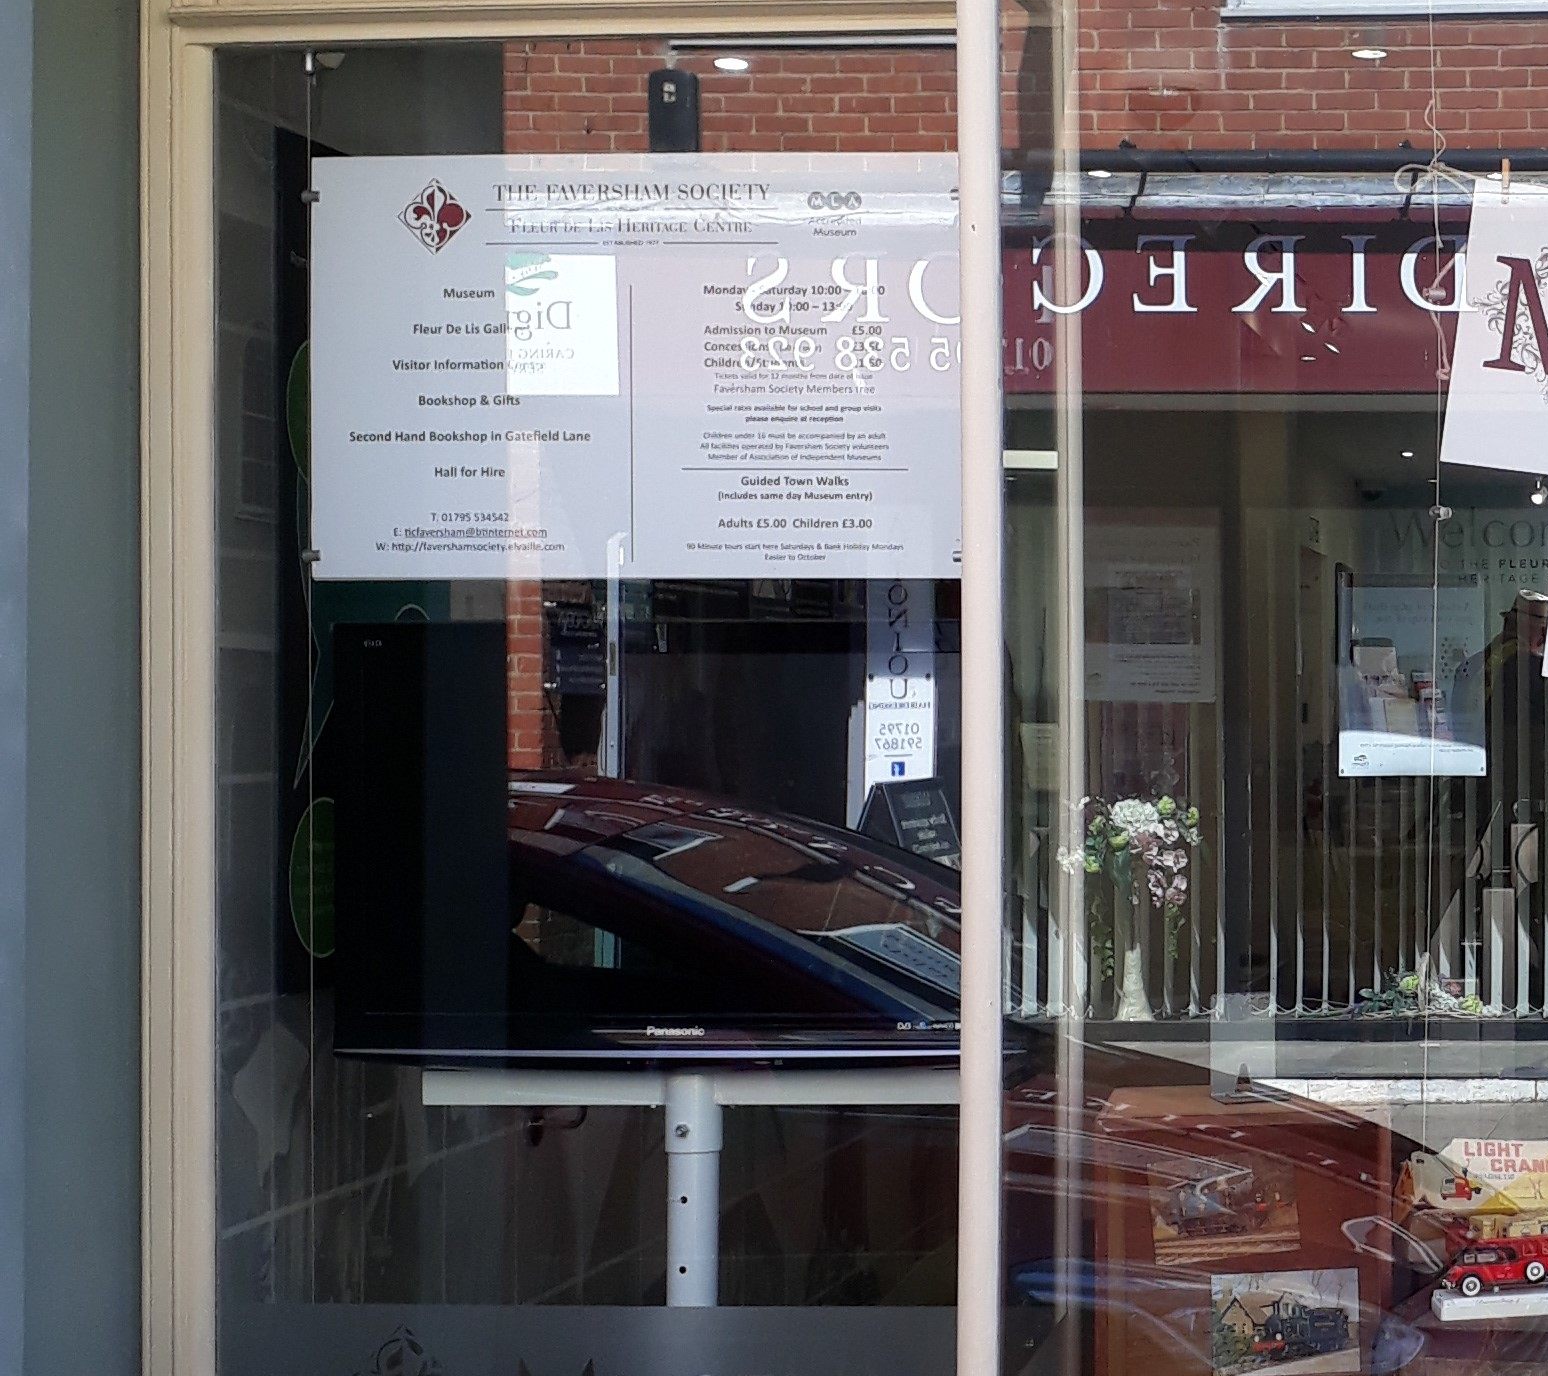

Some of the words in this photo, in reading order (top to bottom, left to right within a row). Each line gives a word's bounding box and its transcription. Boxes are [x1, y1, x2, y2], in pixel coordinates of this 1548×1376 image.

[492, 184, 537, 202] THE
[546, 184, 671, 202] FAVERSHAM
[677, 184, 771, 202] SOCIETY
[813, 226, 858, 238] Museum
[443, 287, 496, 299] Museum
[811, 285, 842, 297] 10:00
[413, 324, 443, 336] Fleur
[446, 324, 463, 336] De
[465, 324, 481, 336] Lis
[703, 326, 762, 336] Admission
[765, 326, 776, 336] to
[779, 326, 828, 336] Museum
[852, 326, 883, 336] £5.00
[392, 359, 432, 371] Visitor
[434, 359, 505, 371] Information
[713, 384, 766, 395] Faversham
[769, 384, 804, 395] Society
[807, 384, 853, 395] Members
[418, 396, 477, 407] Bookshop
[480, 396, 490, 407] &
[493, 396, 521, 407] Gifts
[349, 431, 392, 442] Second
[395, 431, 426, 442] Hand
[430, 431, 488, 442] Bookshop
[490, 431, 502, 442] in
[505, 431, 560, 442] Gatefield
[563, 431, 592, 442] Lane
[434, 467, 457, 477] Hall
[460, 467, 478, 477] for
[481, 467, 506, 477] Hire
[741, 476, 781, 486] Guided
[784, 476, 813, 486] Town
[816, 476, 850, 486] Walks
[717, 492, 758, 502] (Includes
[760, 492, 784, 502] same
[786, 492, 802, 502] day
[804, 492, 843, 502] Museum
[845, 492, 873, 502] entry)
[441, 512, 471, 523] 01795
[474, 512, 510, 523] 534542
[717, 519, 754, 529] Adults
[756, 519, 787, 529] £5.00
[792, 519, 839, 529] Children
[841, 519, 873, 529] £3.00
[646, 1025, 705, 1036] Panasonic
[1463, 1141, 1523, 1158] LIGHT
